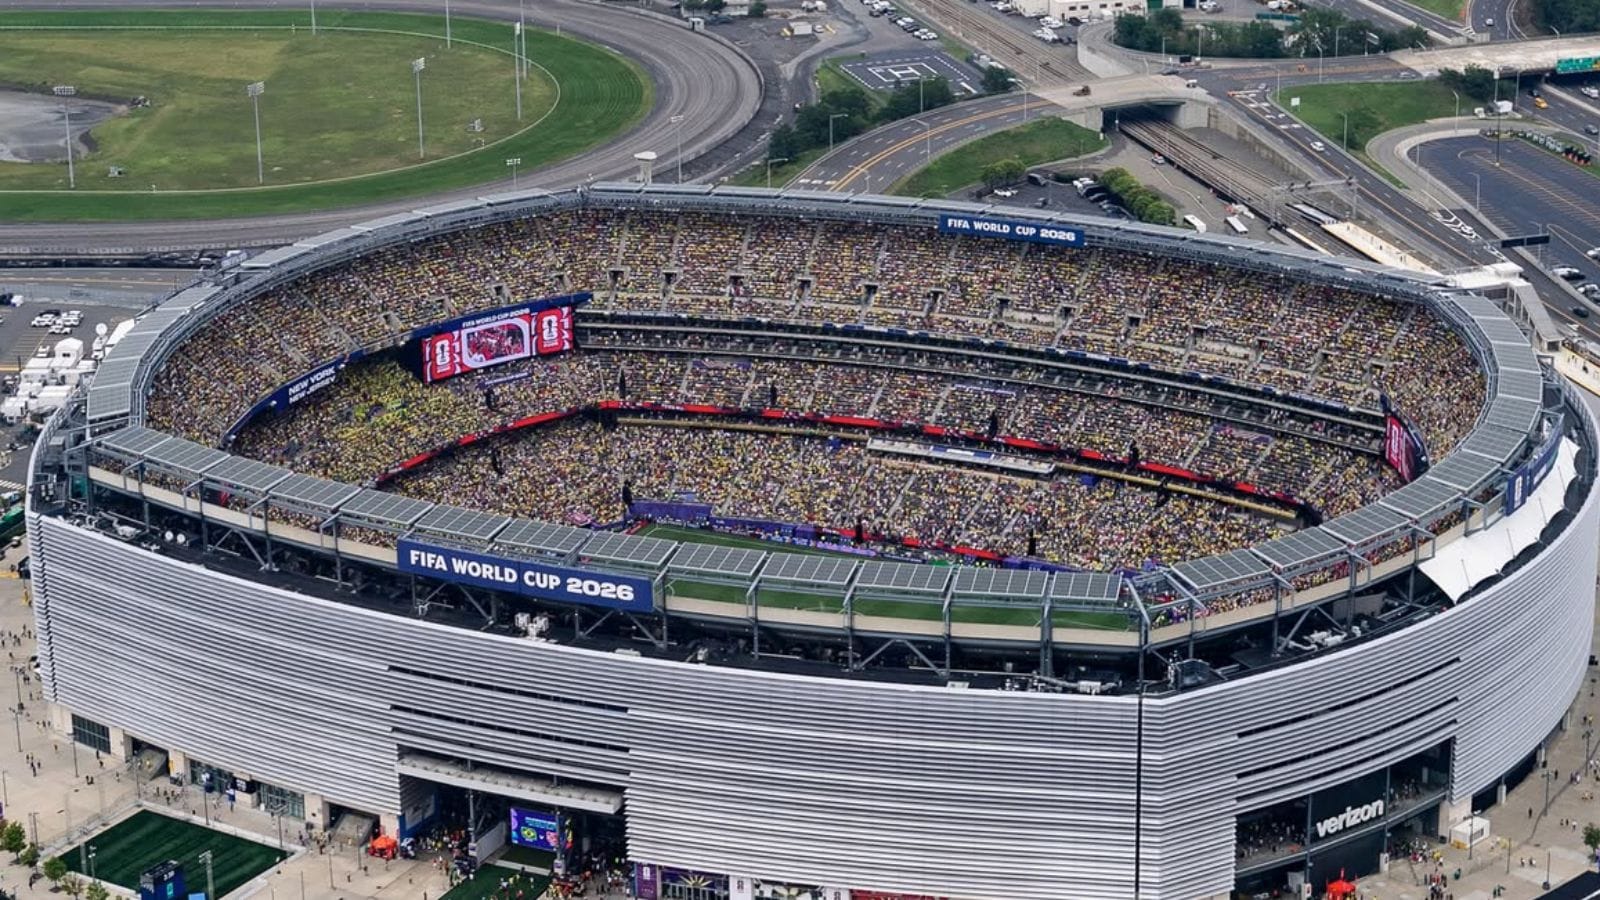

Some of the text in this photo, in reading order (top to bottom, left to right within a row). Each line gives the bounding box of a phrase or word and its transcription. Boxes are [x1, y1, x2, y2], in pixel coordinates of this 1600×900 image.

[887, 66, 922, 78] H
[947, 218, 1076, 241] FIFA WORLD CUP 2026
[475, 315, 497, 325] WORLD
[497, 313, 509, 321] CUP
[510, 307, 530, 317] 2026
[288, 366, 336, 396] NEW YORK
[289, 375, 336, 404] NEW JERSEY
[409, 549, 635, 602] FIFA WORLD CUP 2026
[1316, 799, 1384, 838] verizon
